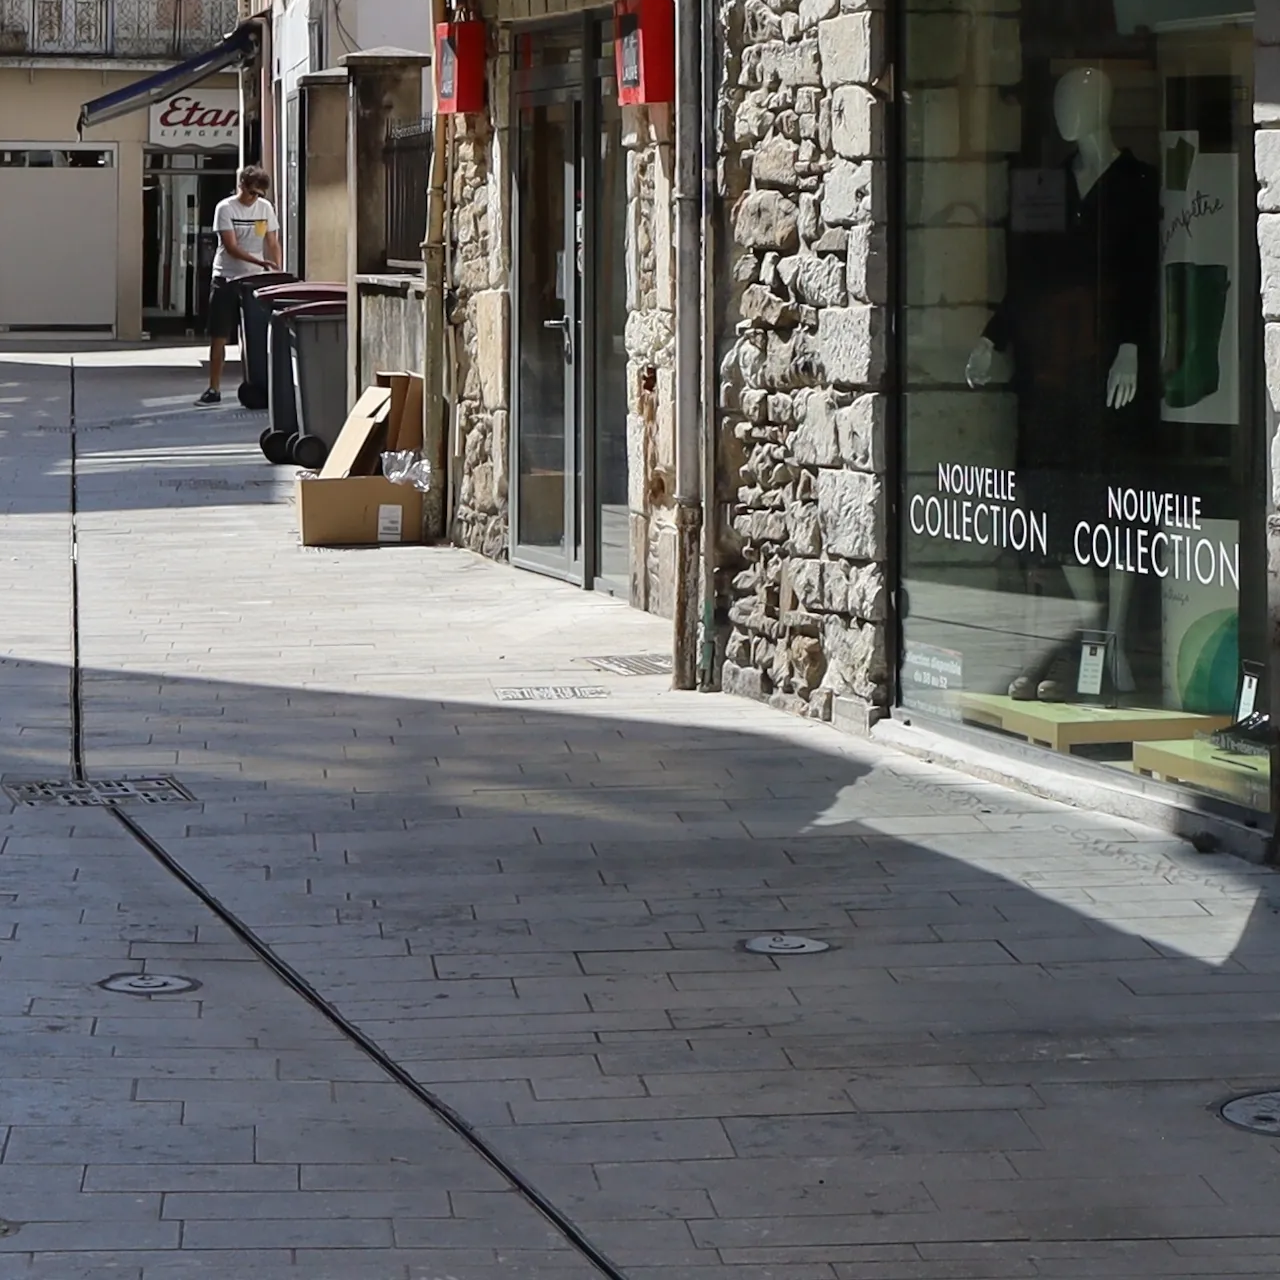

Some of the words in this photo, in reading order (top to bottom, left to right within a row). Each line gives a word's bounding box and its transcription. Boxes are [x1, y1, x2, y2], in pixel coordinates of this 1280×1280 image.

[938, 462, 1016, 502] NOUVELLE
[1107, 486, 1202, 531] NOUVELLE
[910, 494, 1048, 556] COLLECTION
[1074, 521, 1240, 591] COLLECTION
